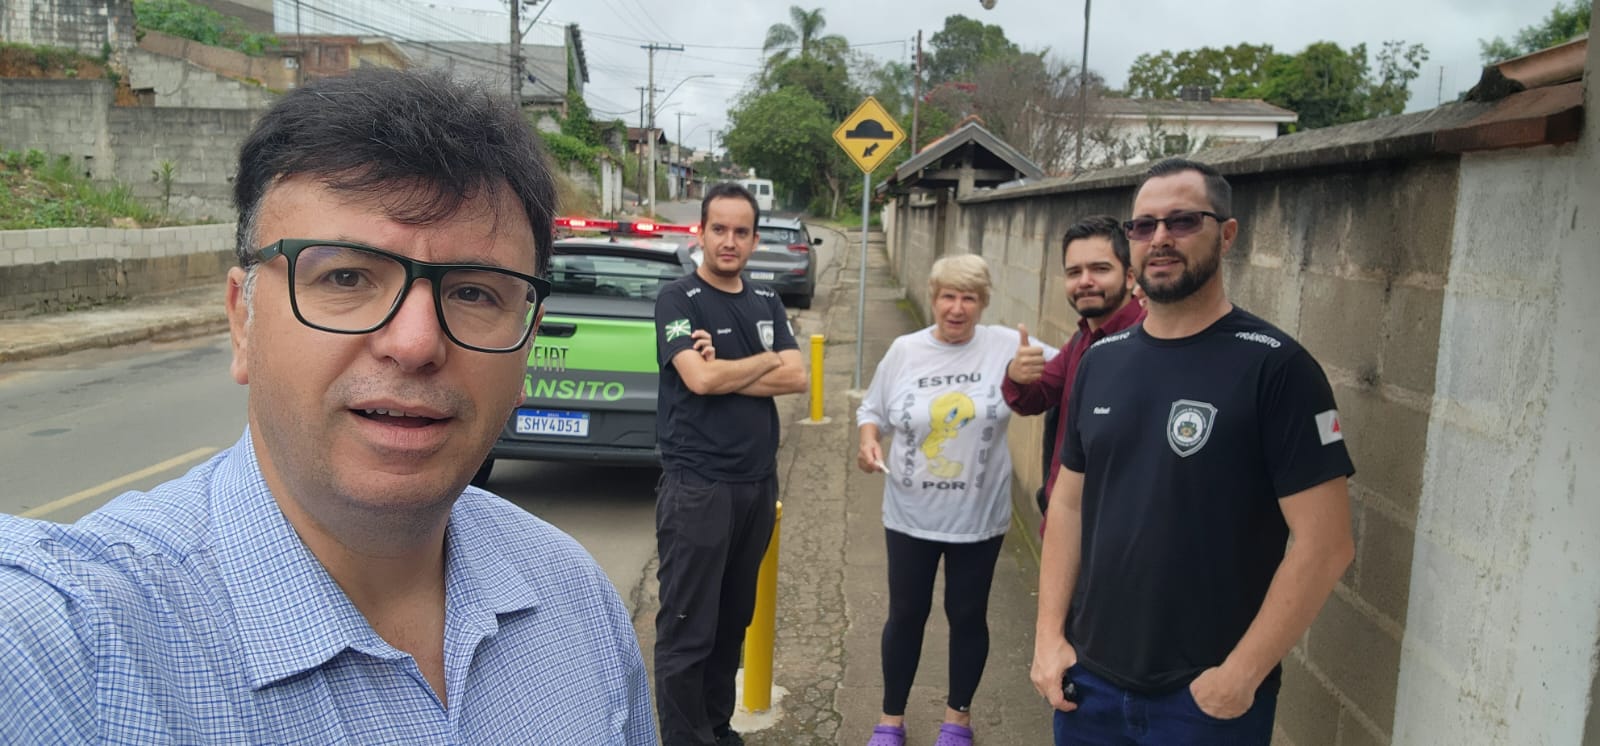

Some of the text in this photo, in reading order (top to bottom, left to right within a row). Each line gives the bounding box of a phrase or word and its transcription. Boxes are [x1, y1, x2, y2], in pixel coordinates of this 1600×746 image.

[533, 345, 569, 372] FIAT
[525, 374, 625, 401] ÂNSITO
[918, 373, 982, 388] ESTOU
[524, 417, 581, 433] SHY4D51
[922, 480, 966, 490] POR
